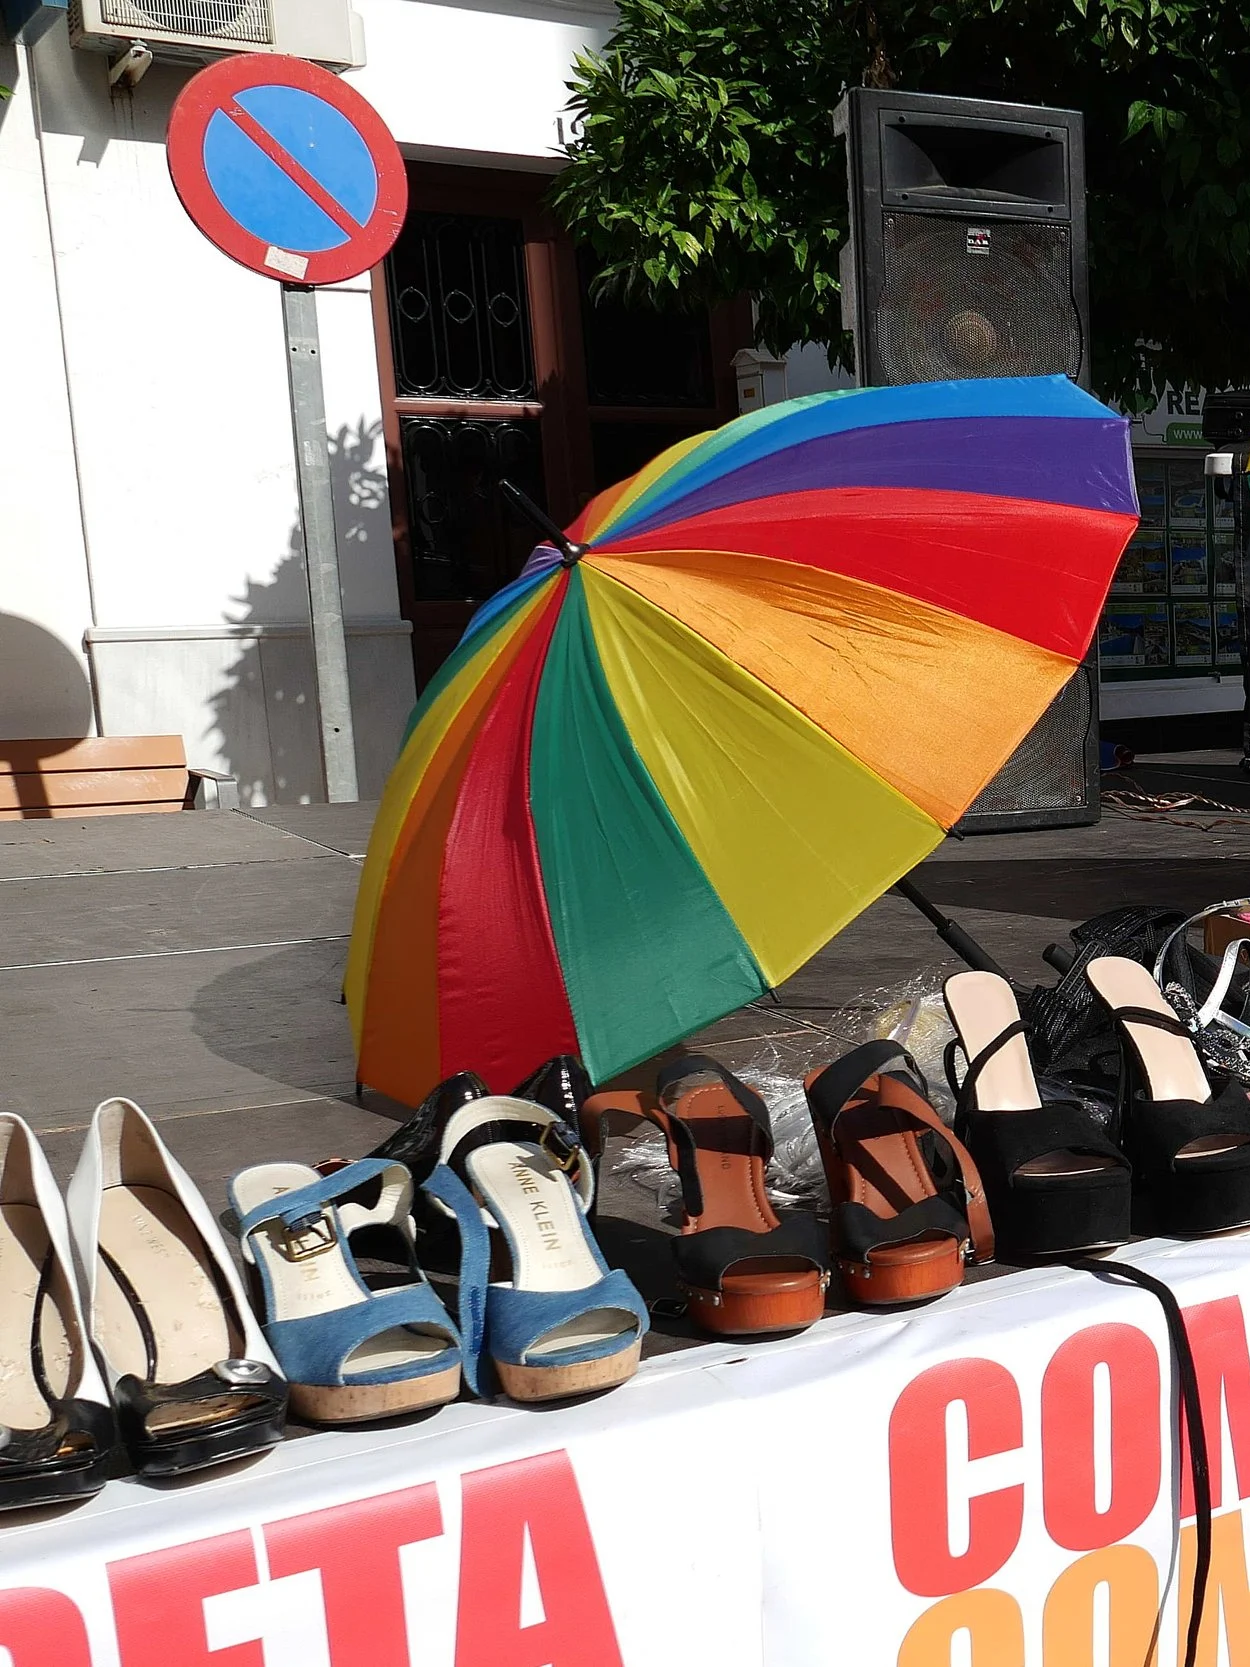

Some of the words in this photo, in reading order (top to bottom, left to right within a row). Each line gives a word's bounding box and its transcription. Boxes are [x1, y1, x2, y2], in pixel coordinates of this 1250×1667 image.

[1166, 390, 1203, 415] RE
[508, 1161, 540, 1195] ANNE
[528, 1200, 562, 1252] KLEIN
